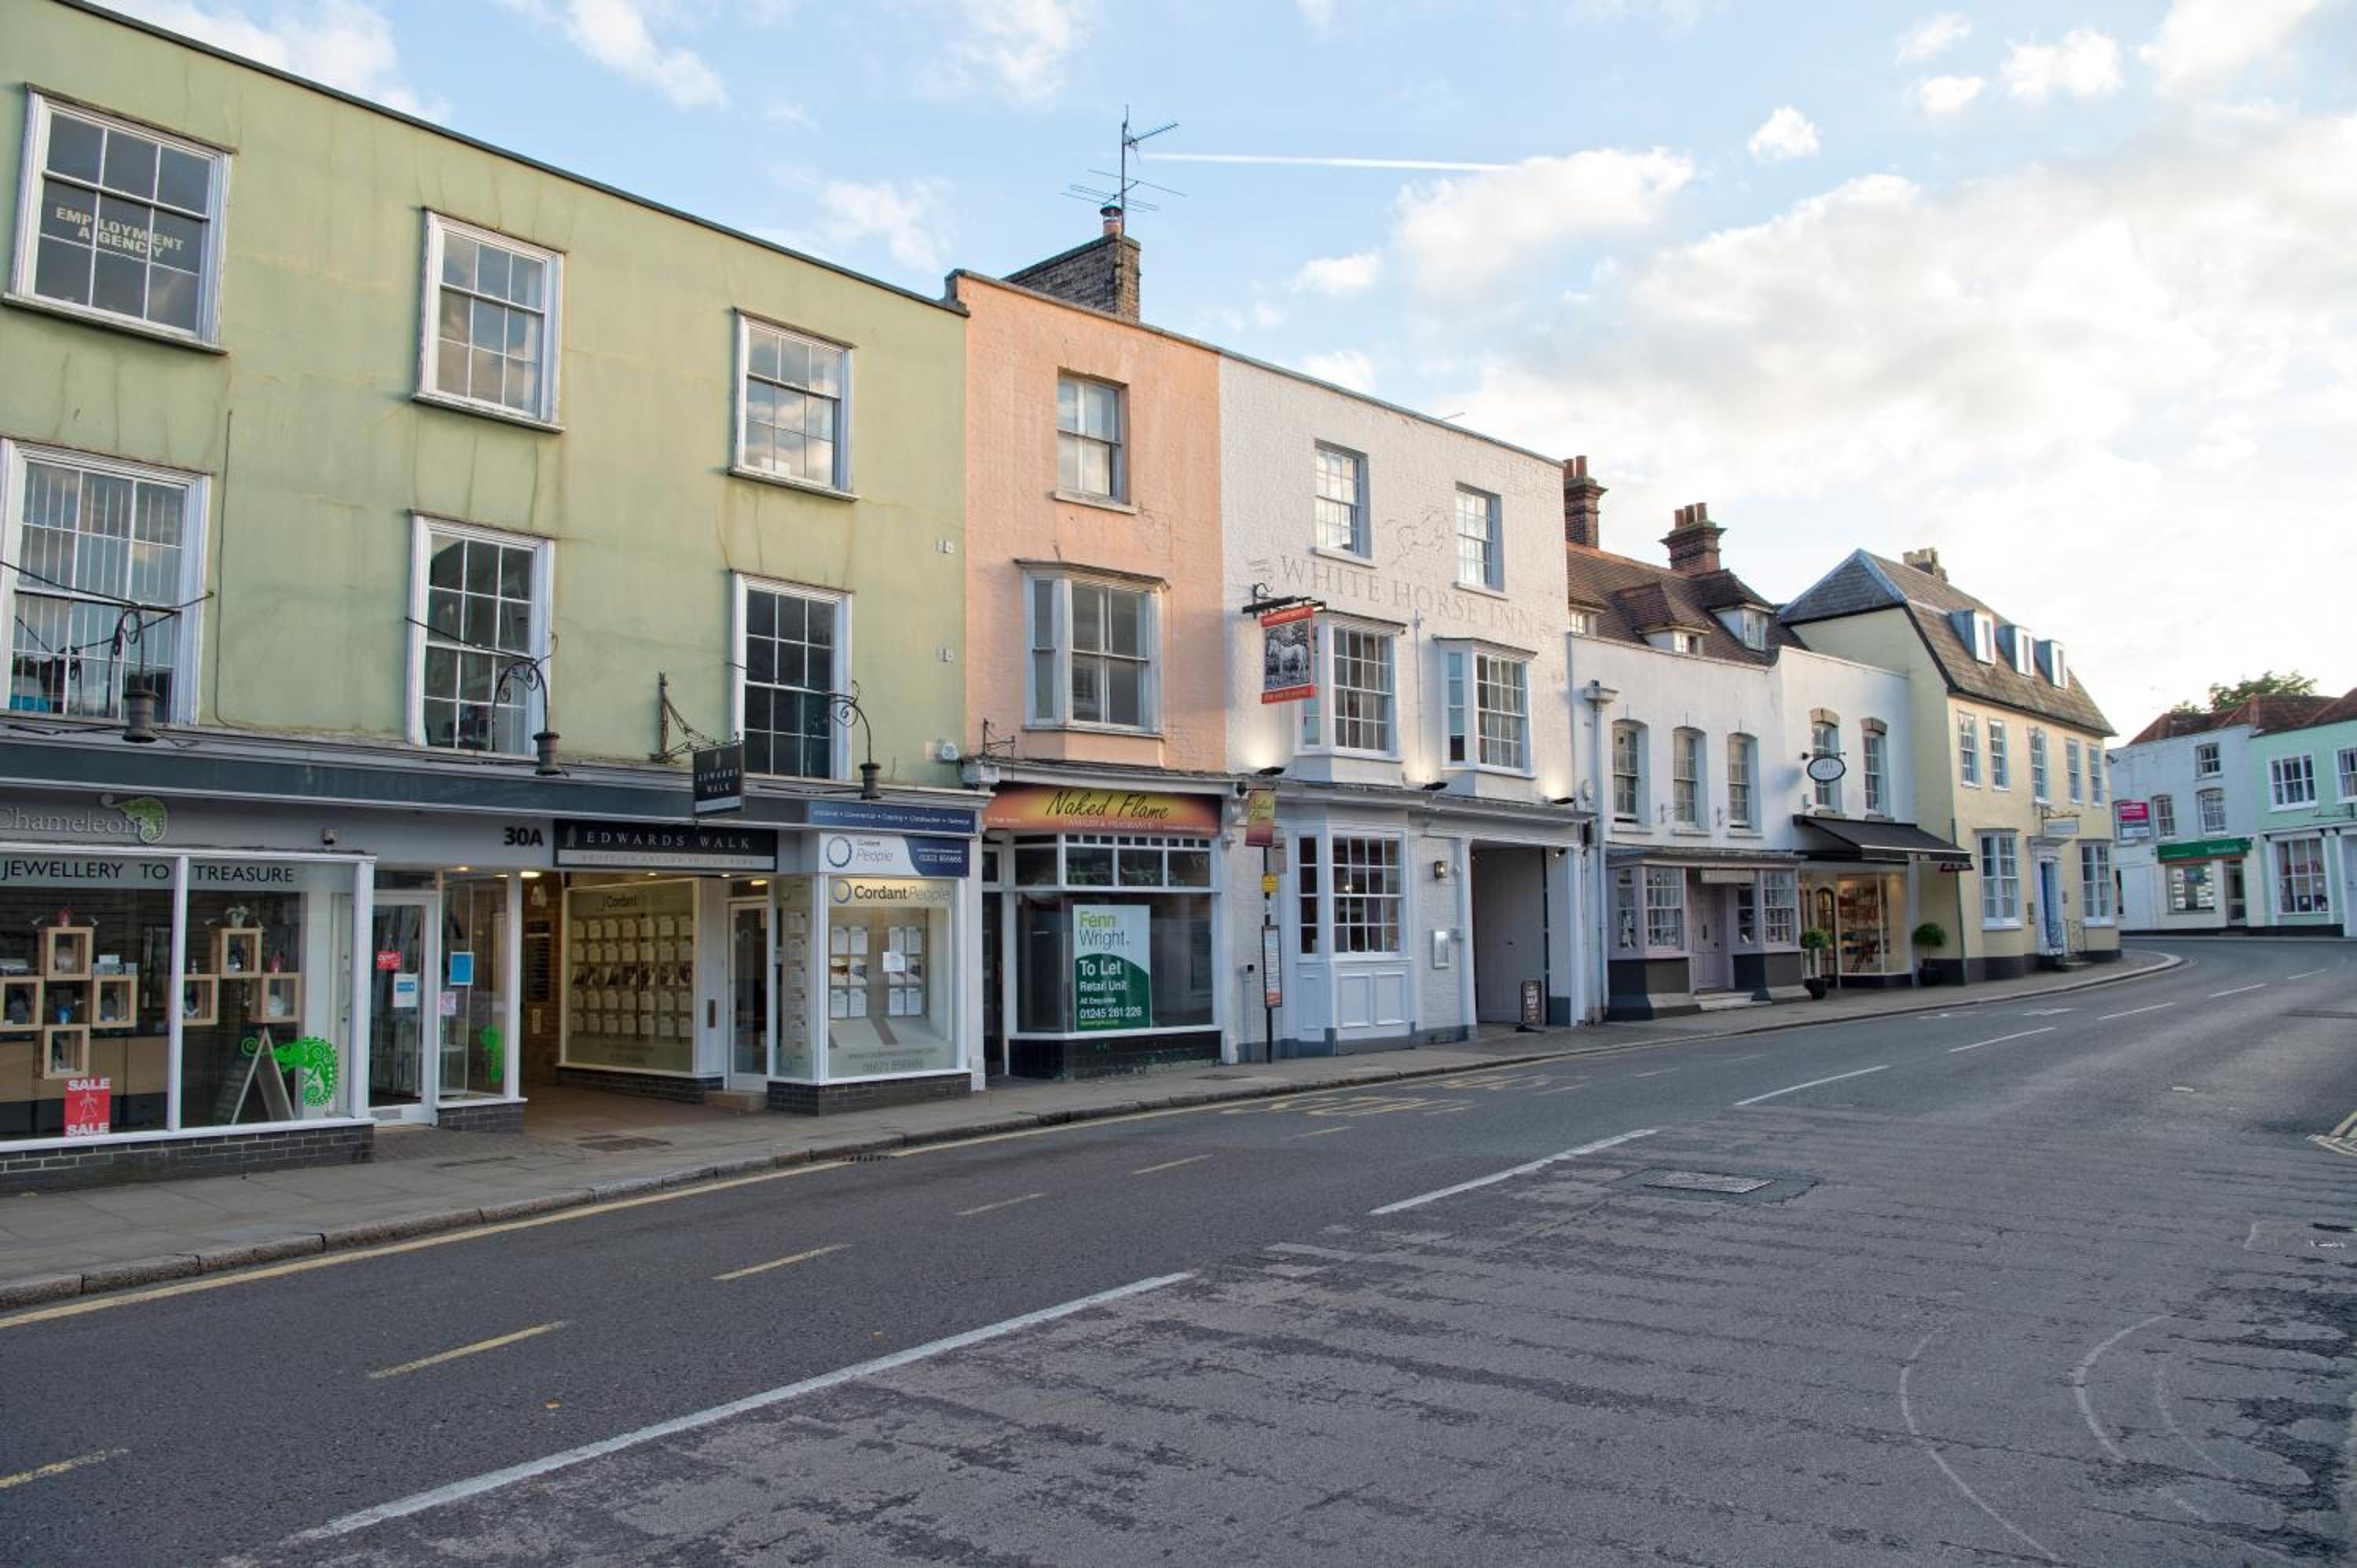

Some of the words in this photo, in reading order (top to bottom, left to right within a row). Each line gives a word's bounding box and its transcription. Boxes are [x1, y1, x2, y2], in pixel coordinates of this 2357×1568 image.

[56, 207, 184, 251] EMPLOYMENT
[79, 226, 164, 258] AGENCY
[1281, 556, 1380, 601] WHITE
[1393, 580, 1480, 621] HORSE
[1490, 602, 1534, 632] INN
[1046, 790, 1113, 816] Naked
[1117, 793, 1170, 819] Flame
[503, 827, 544, 847] 30A
[586, 830, 685, 847] EDWARDS
[700, 835, 750, 850] WALK
[856, 848, 893, 863] People
[2, 860, 123, 881] JEWELLERY
[139, 864, 170, 880] TO
[193, 866, 296, 882] TREASURE
[854, 885, 907, 899] Cordant
[908, 886, 951, 902] People
[1080, 911, 1116, 928] Fenn
[1079, 960, 1096, 976] To
[1101, 959, 1122, 976] Let
[1080, 982, 1107, 991] Retail
[1109, 980, 1128, 991] Unit
[1080, 1008, 1107, 1019] 01245
[68, 1079, 111, 1091] SALE
[66, 1123, 110, 1137] SALE
